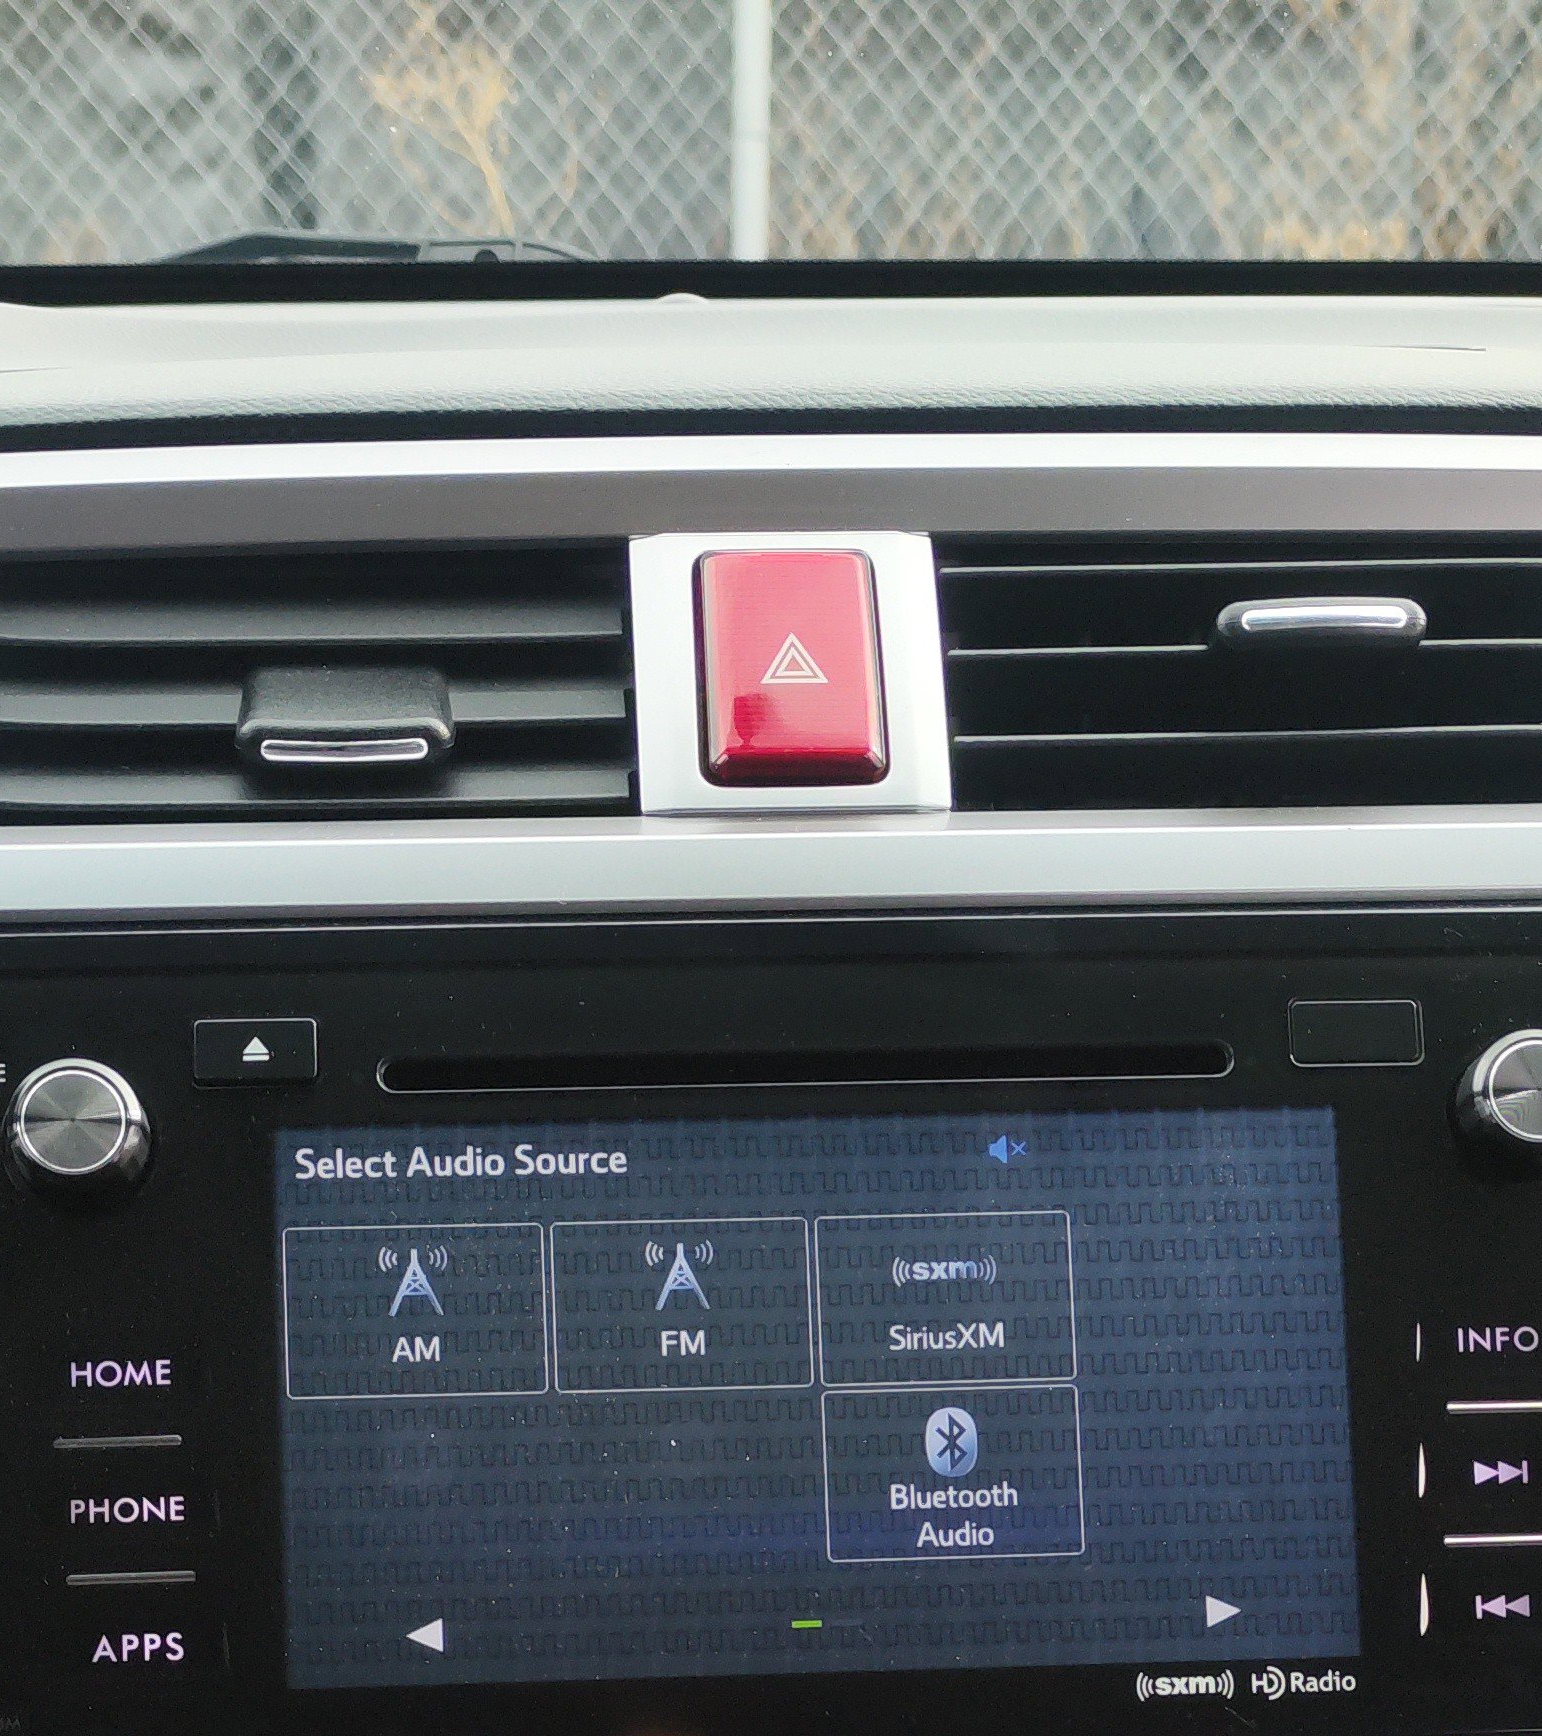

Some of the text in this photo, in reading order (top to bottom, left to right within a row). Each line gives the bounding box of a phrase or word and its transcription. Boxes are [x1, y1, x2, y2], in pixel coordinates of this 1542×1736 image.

[295, 1143, 628, 1180] Select Audio Source
[392, 1335, 441, 1363] AM
[660, 1329, 706, 1357] FM
[889, 1321, 1005, 1351] SiriusXM
[1457, 1325, 1539, 1353] INFO
[70, 1359, 171, 1387] HOME
[890, 1480, 1018, 1510] Bluetooth
[70, 1495, 185, 1524] PHONE
[916, 1520, 995, 1548] Audio
[92, 1632, 185, 1663] APPS
[1290, 1669, 1357, 1693] Radio
